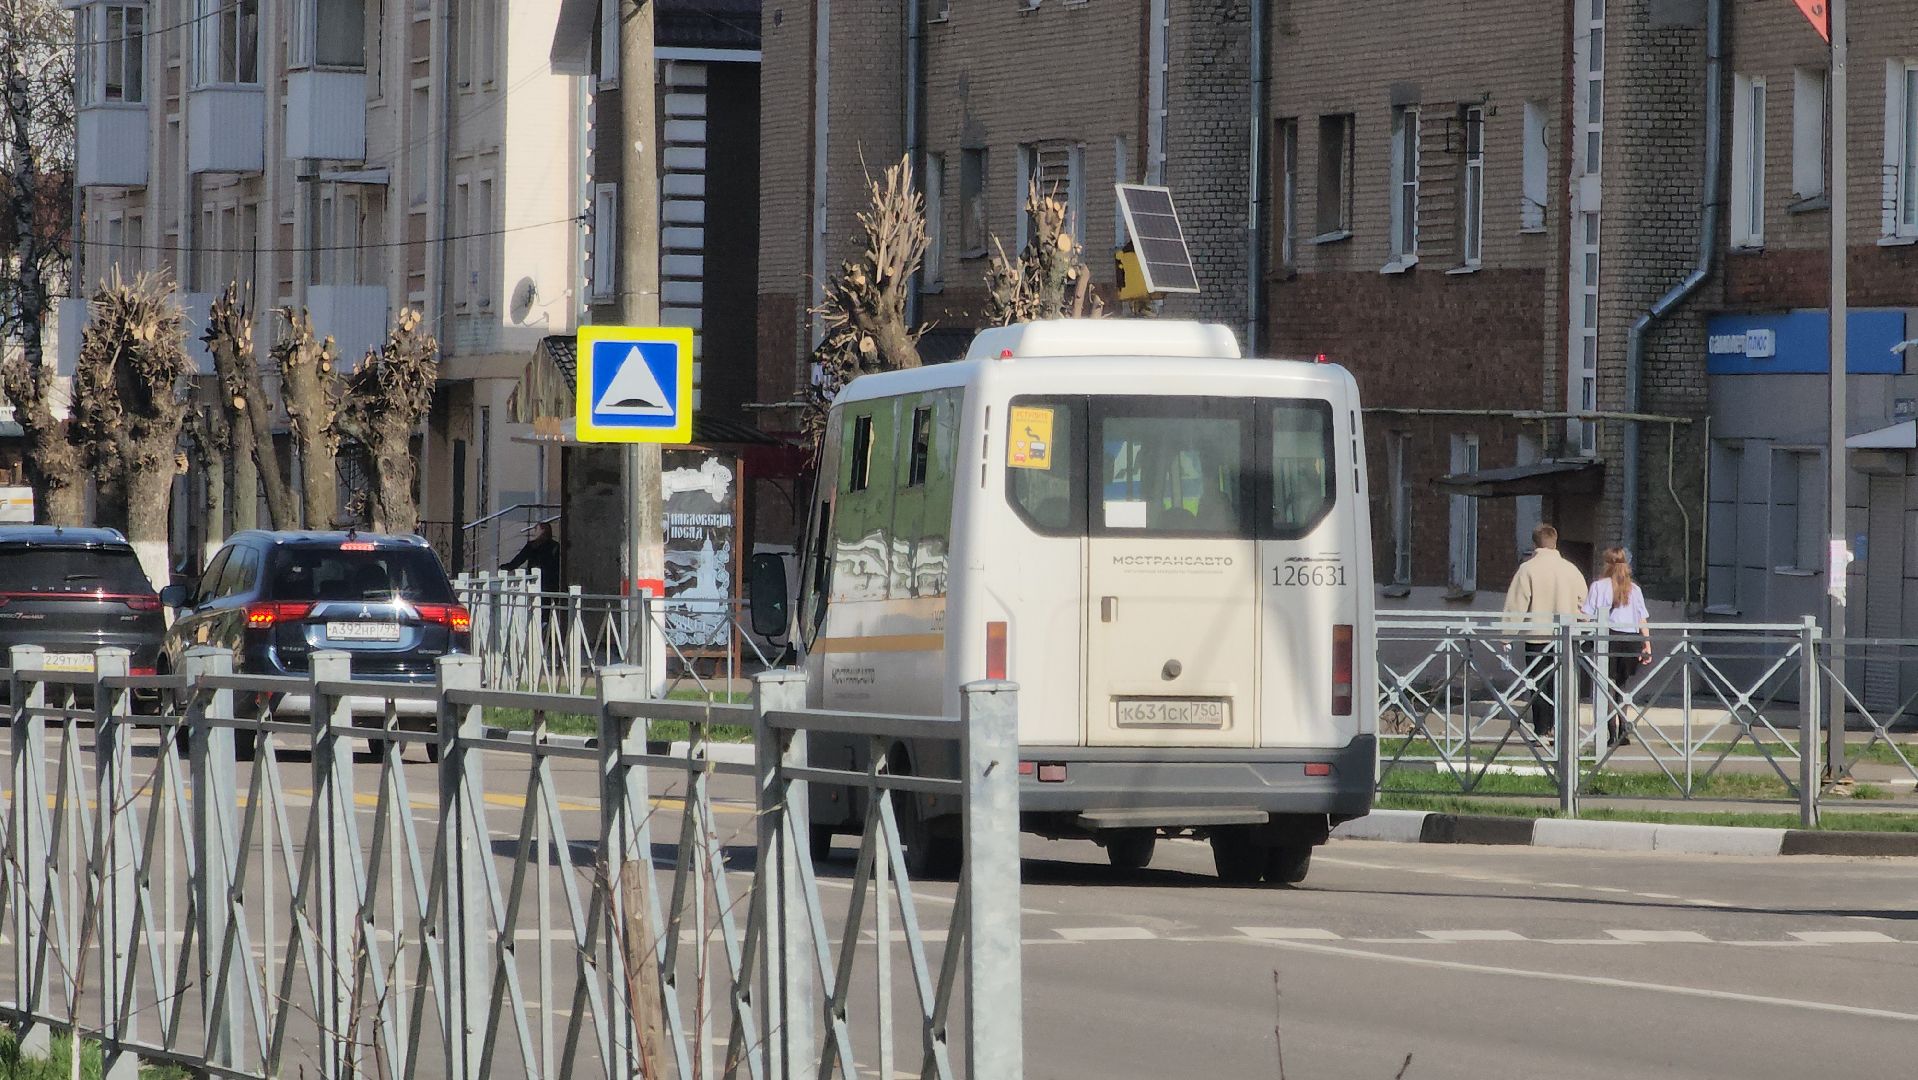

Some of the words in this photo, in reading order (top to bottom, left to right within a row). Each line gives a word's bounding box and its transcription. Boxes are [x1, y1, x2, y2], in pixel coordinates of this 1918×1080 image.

[1113, 556, 1233, 567] МОСТРАНСАВТО
[1272, 565, 1347, 586] 126631
[45, 655, 78, 665] 229ТУ
[1124, 703, 1189, 721] К631СК
[1192, 703, 1218, 717] 750
